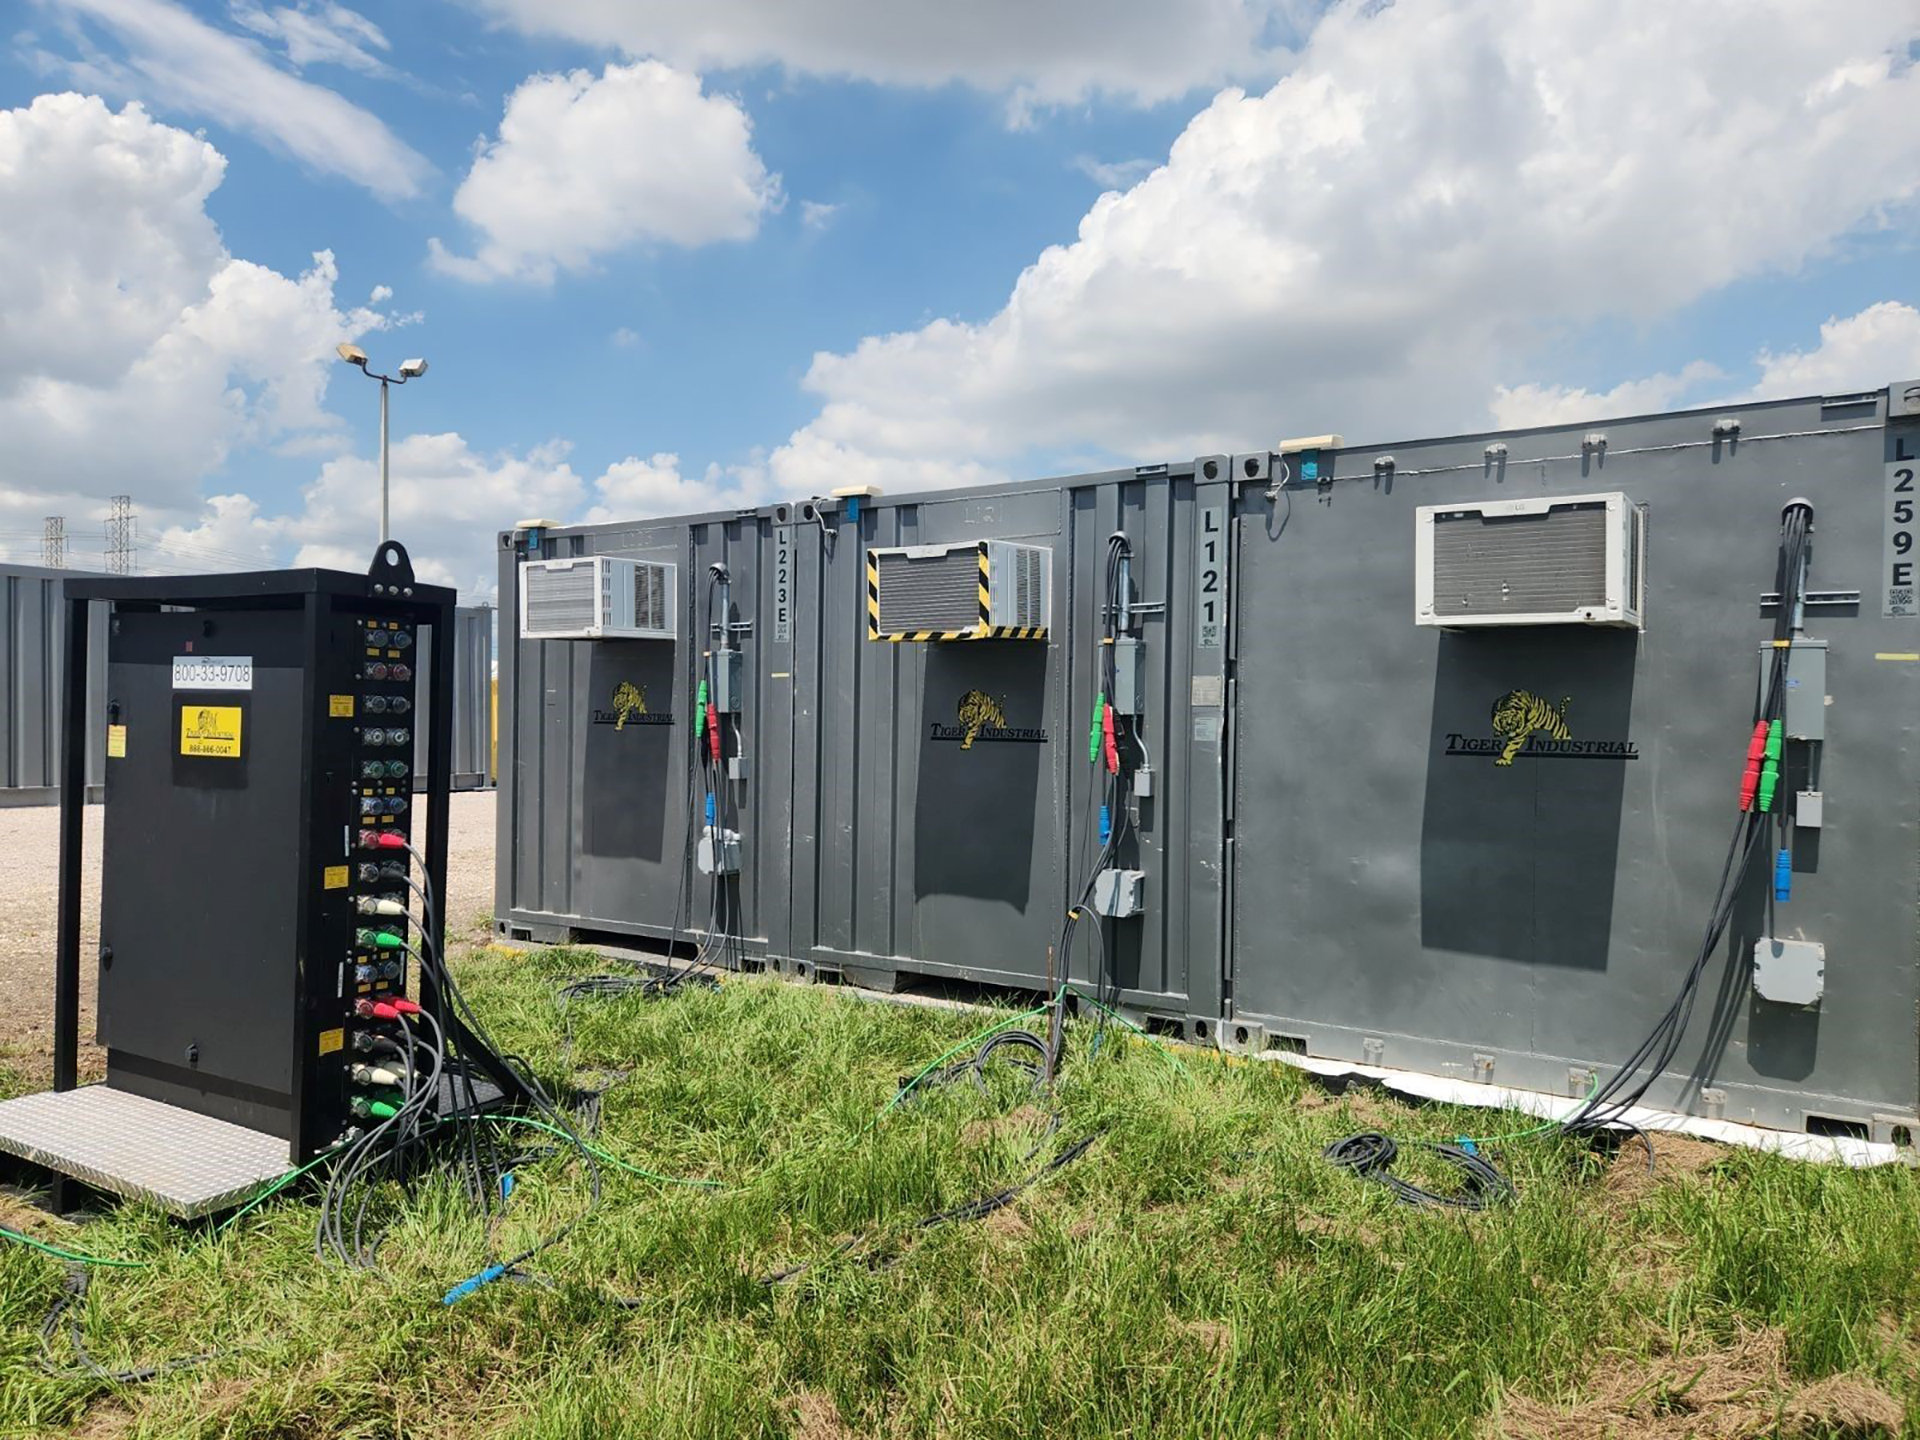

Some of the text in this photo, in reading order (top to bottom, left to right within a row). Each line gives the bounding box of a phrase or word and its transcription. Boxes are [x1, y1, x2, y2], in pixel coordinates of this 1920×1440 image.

[1892, 438, 1915, 586] L259E
[778, 530, 787, 623] L223E
[1202, 510, 1219, 623] L121
[174, 664, 250, 682] 800-33-9708
[980, 724, 1048, 739] INDUSTRIAL
[1446, 733, 1639, 754] TIGER INDUSTRIAL
